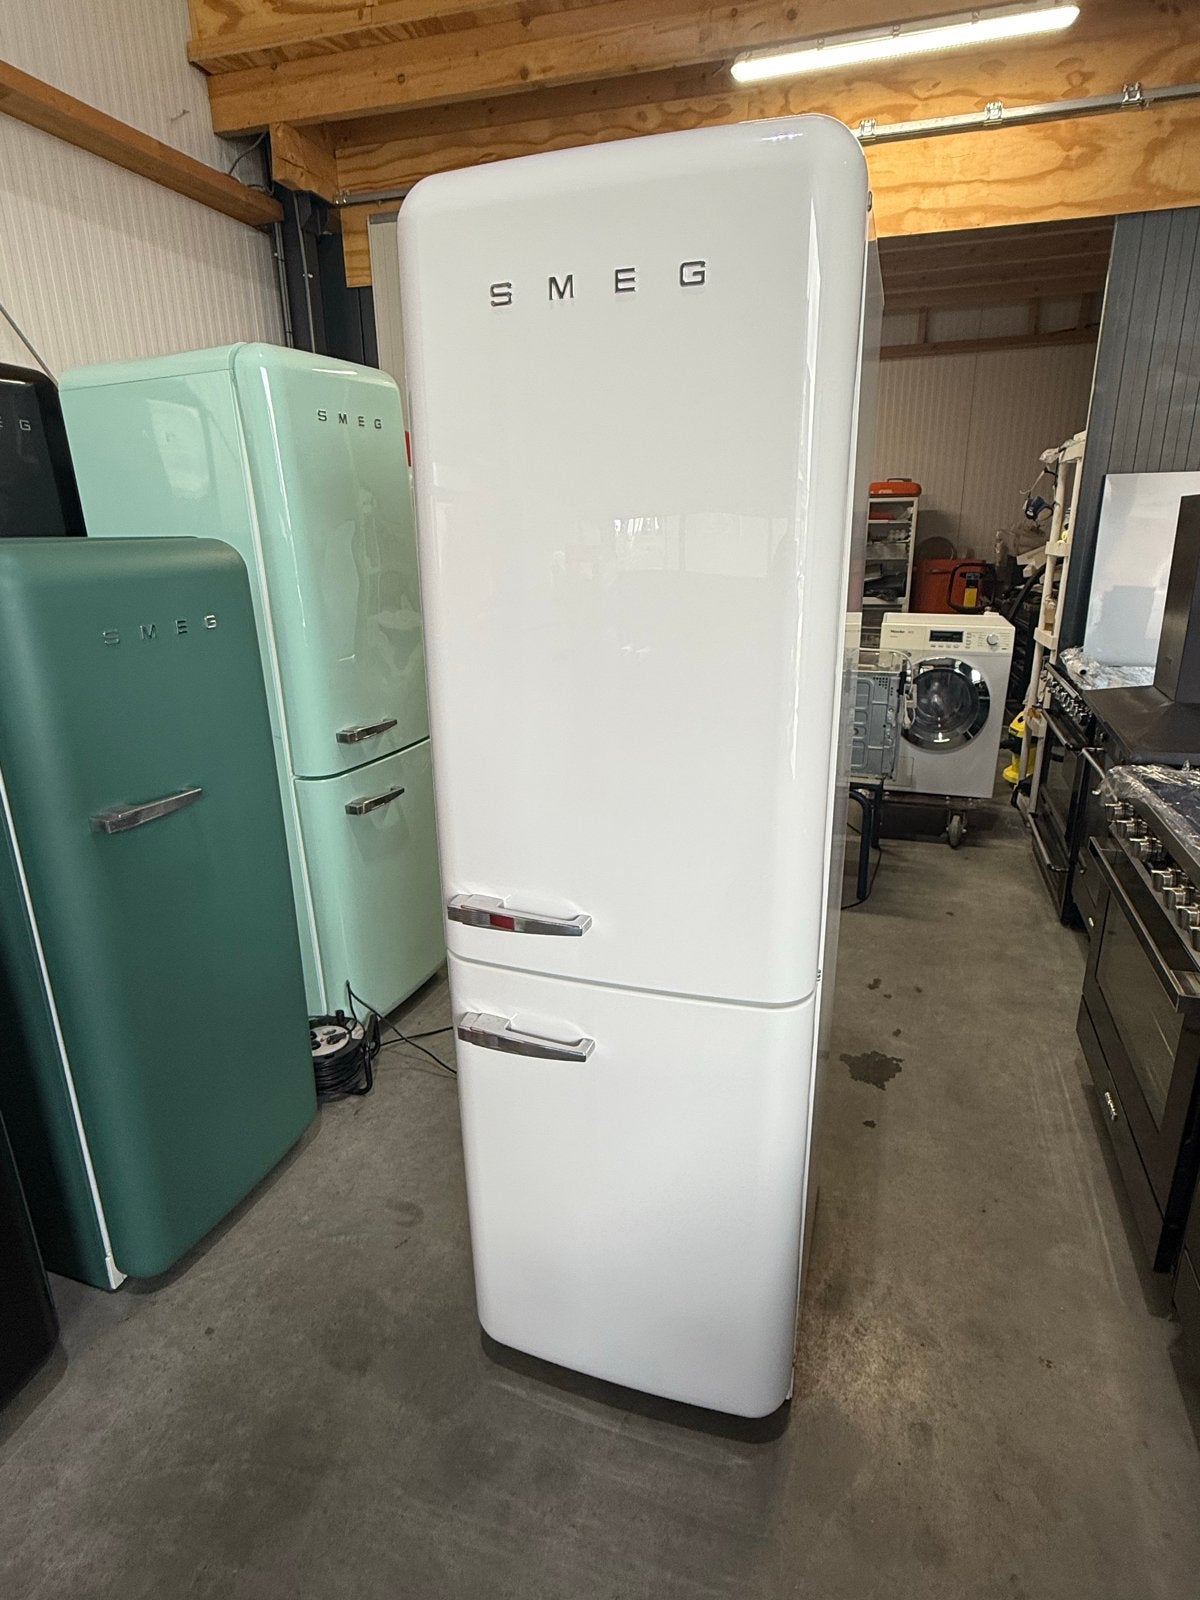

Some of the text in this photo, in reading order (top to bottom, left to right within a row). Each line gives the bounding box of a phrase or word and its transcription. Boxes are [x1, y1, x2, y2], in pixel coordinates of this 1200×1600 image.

[489, 260, 706, 307] SMEG
[317, 409, 382, 429] SMEG
[102, 614, 217, 645] SMEG
